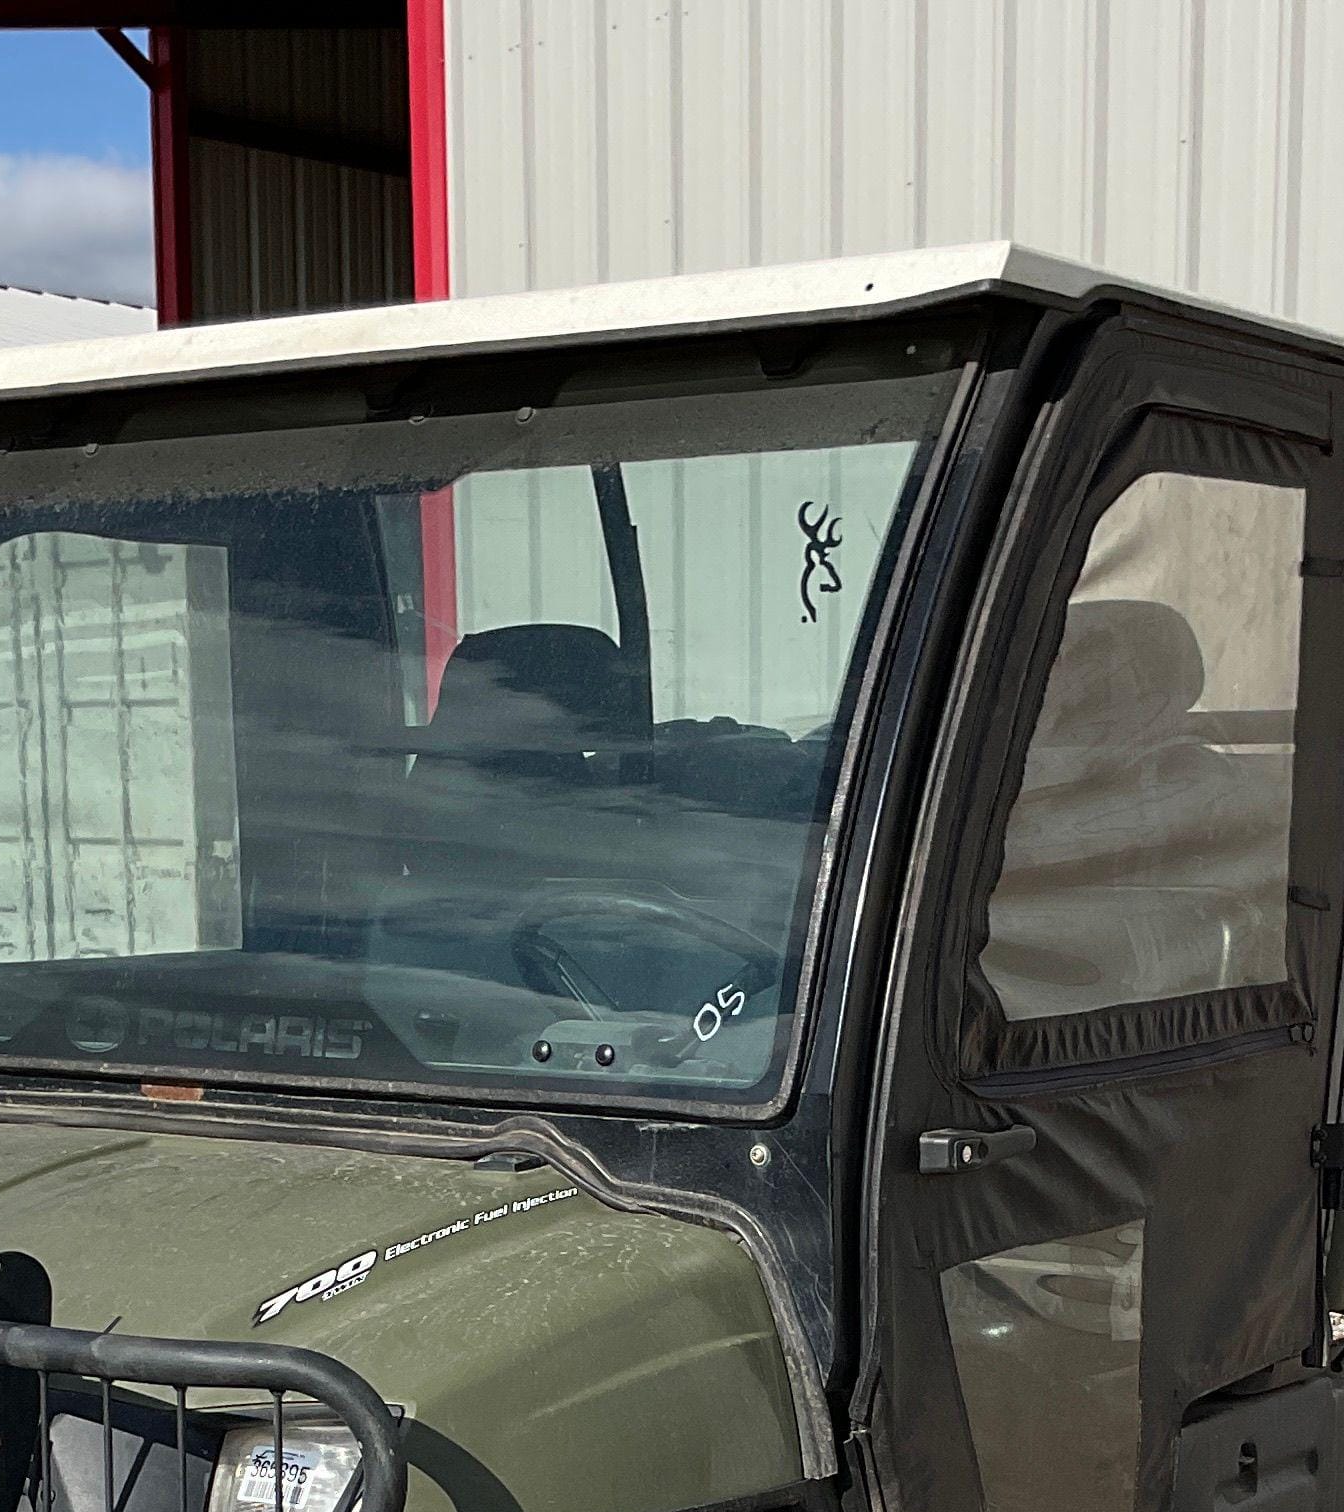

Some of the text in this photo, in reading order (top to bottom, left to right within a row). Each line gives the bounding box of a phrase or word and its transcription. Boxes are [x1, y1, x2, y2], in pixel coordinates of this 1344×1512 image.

[138, 1007, 373, 1059] POLARIS
[693, 984, 745, 1042] 05
[253, 1186, 578, 1327] 700 Electronic Fuel Injection
